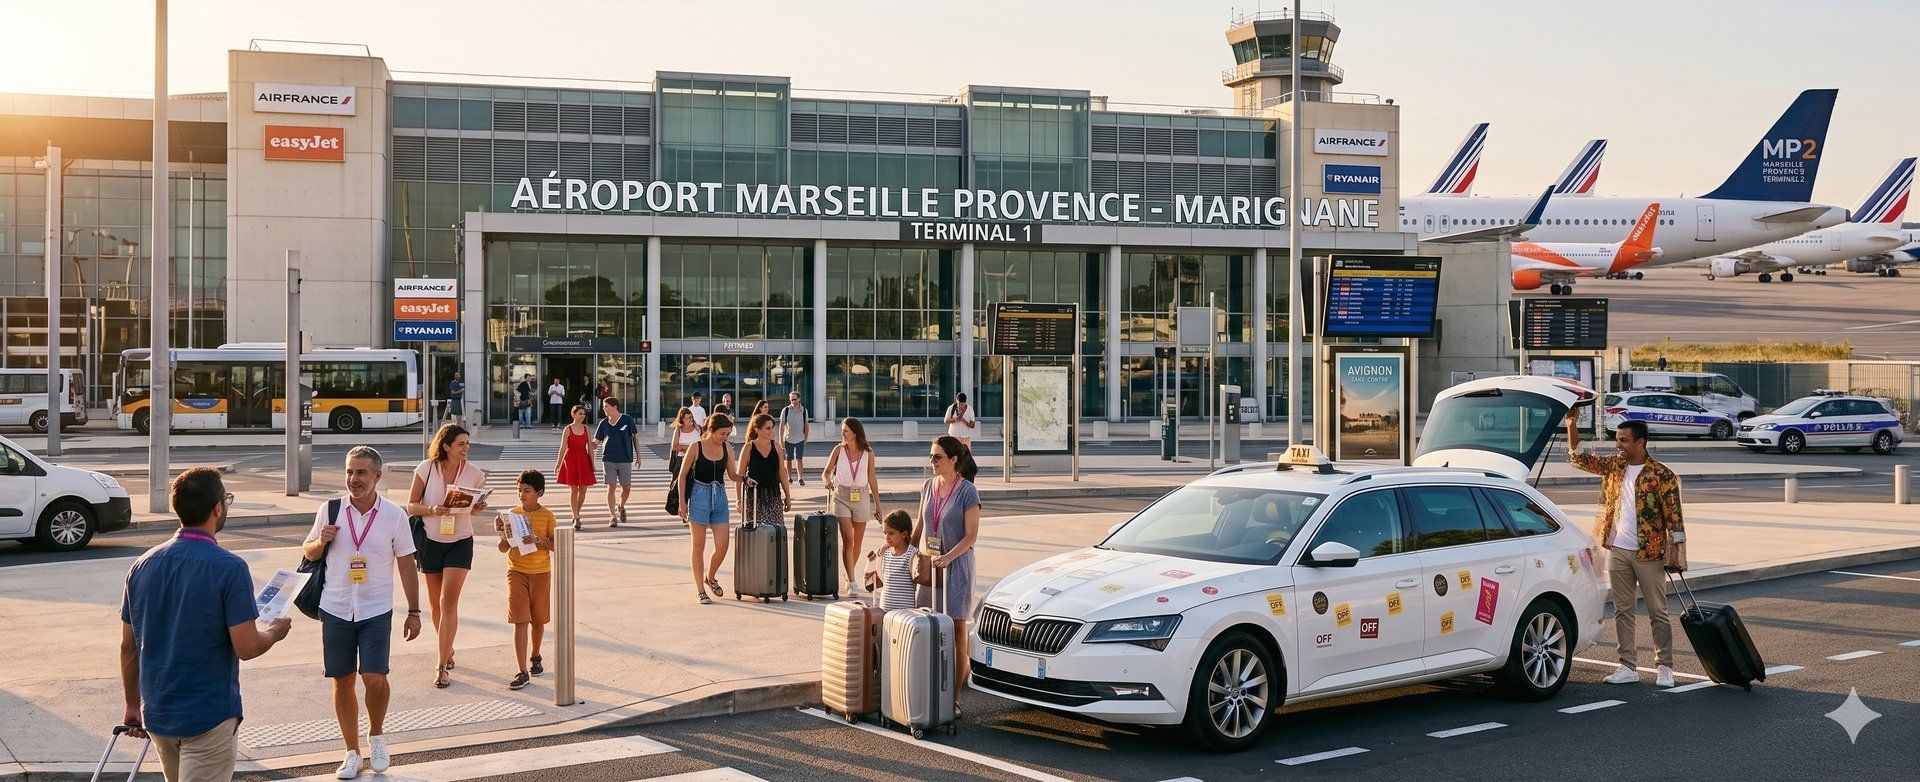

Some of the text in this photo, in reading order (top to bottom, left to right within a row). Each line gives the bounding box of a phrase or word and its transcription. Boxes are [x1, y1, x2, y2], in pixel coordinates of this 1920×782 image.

[258, 93, 338, 105] AIRFRANCE
[270, 135, 339, 151] easyJet
[1319, 137, 1376, 147] AIRFRANCE
[1763, 139, 1817, 159] MP2
[1334, 174, 1379, 184] RYANAIR
[510, 170, 722, 213] AÉROPORT
[736, 182, 939, 218] MARSEILLE
[954, 188, 1140, 222] PROVENCE
[910, 222, 1032, 242] TERMINAL 1
[397, 284, 447, 292] AIRFRANCE
[400, 303, 451, 315] easyJet
[405, 326, 453, 335] RYANAIR
[1347, 365, 1393, 376] AVIGNON
[1291, 447, 1310, 458] TAXI
[1361, 622, 1378, 633] OFF
[1316, 633, 1332, 644] OFF
